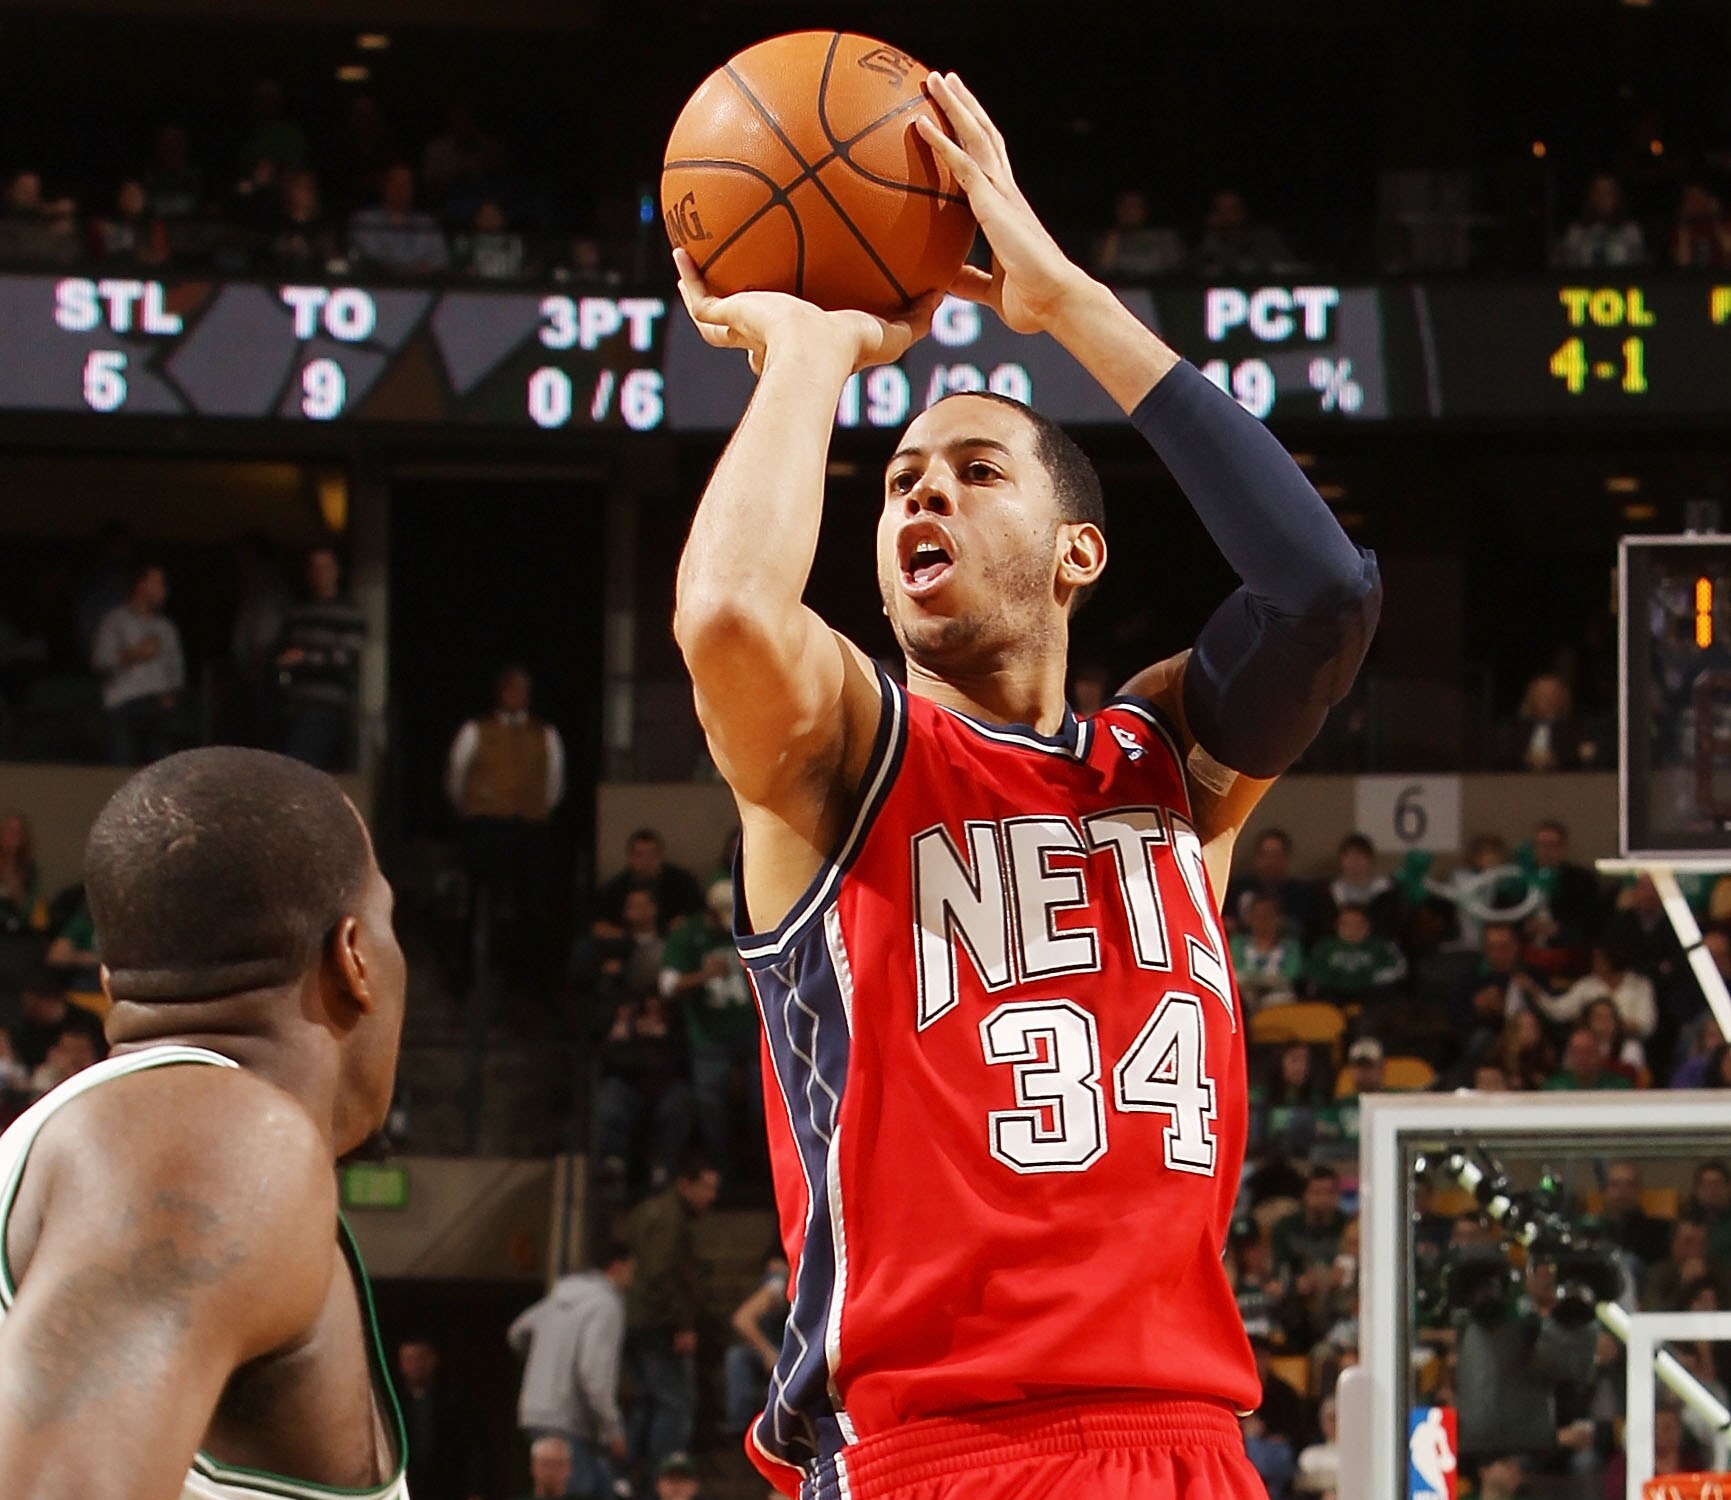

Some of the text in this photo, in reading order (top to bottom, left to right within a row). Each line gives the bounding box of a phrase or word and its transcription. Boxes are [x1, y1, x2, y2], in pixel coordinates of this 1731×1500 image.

[54, 277, 184, 335] STL
[279, 285, 377, 342] TO
[538, 294, 667, 351] 3PT
[1205, 286, 1340, 342] PCT
[1559, 286, 1656, 328] TOL
[301, 356, 346, 421] 9
[1548, 335, 1649, 394] 4-1
[1394, 786, 1428, 842] 6
[911, 804, 1236, 1033] NETS
[978, 990, 1216, 1177] 34
